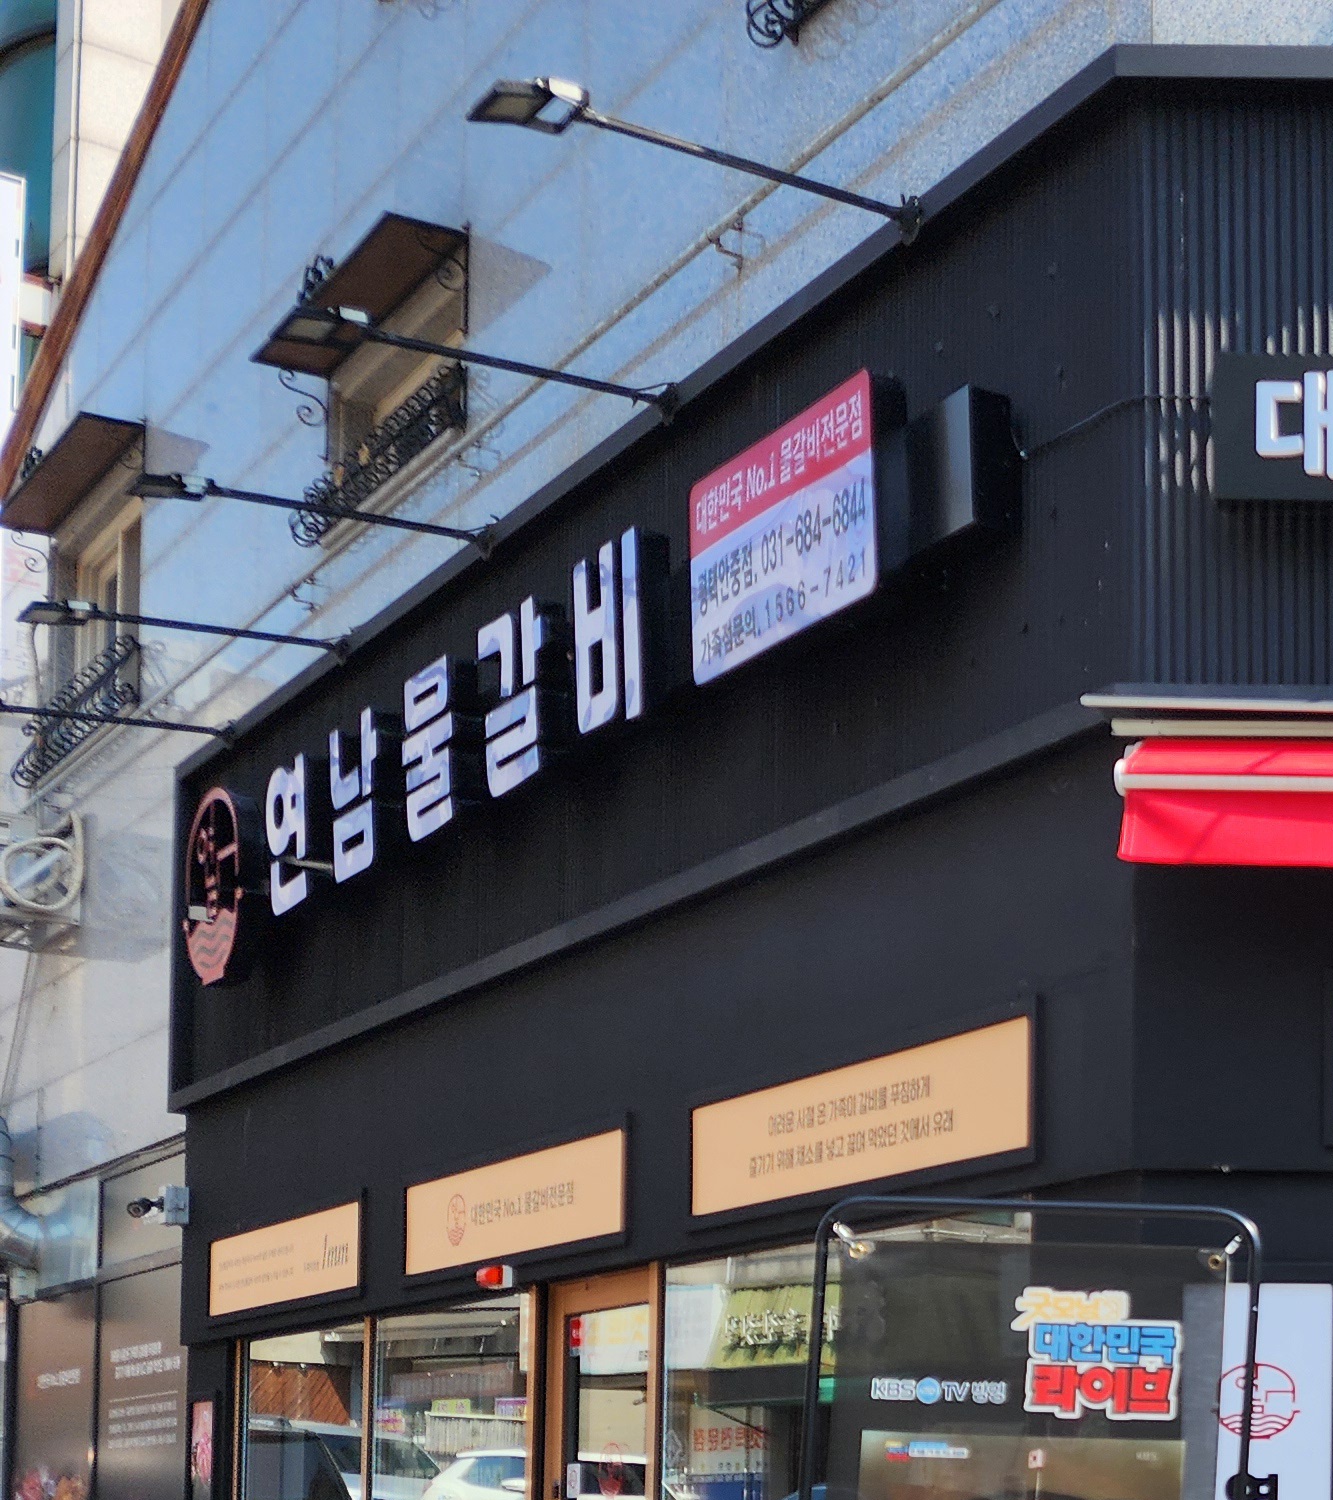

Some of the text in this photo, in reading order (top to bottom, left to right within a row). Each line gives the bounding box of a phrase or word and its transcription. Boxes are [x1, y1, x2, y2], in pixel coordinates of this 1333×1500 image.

[696, 390, 863, 534] 대한민국 No.1 물갈비전문점
[761, 477, 867, 577] 031-684-6844
[265, 526, 644, 916] 연남물갈비
[828, 1095, 857, 1124] 가족이
[859, 1087, 888, 1116] 갈비를
[889, 1074, 931, 1107] 푸짐하게
[1035, 1322, 1176, 1365] 대한민국
[871, 1377, 1008, 1404] KBS TV 방영
[1031, 1364, 1173, 1414] 라이브
